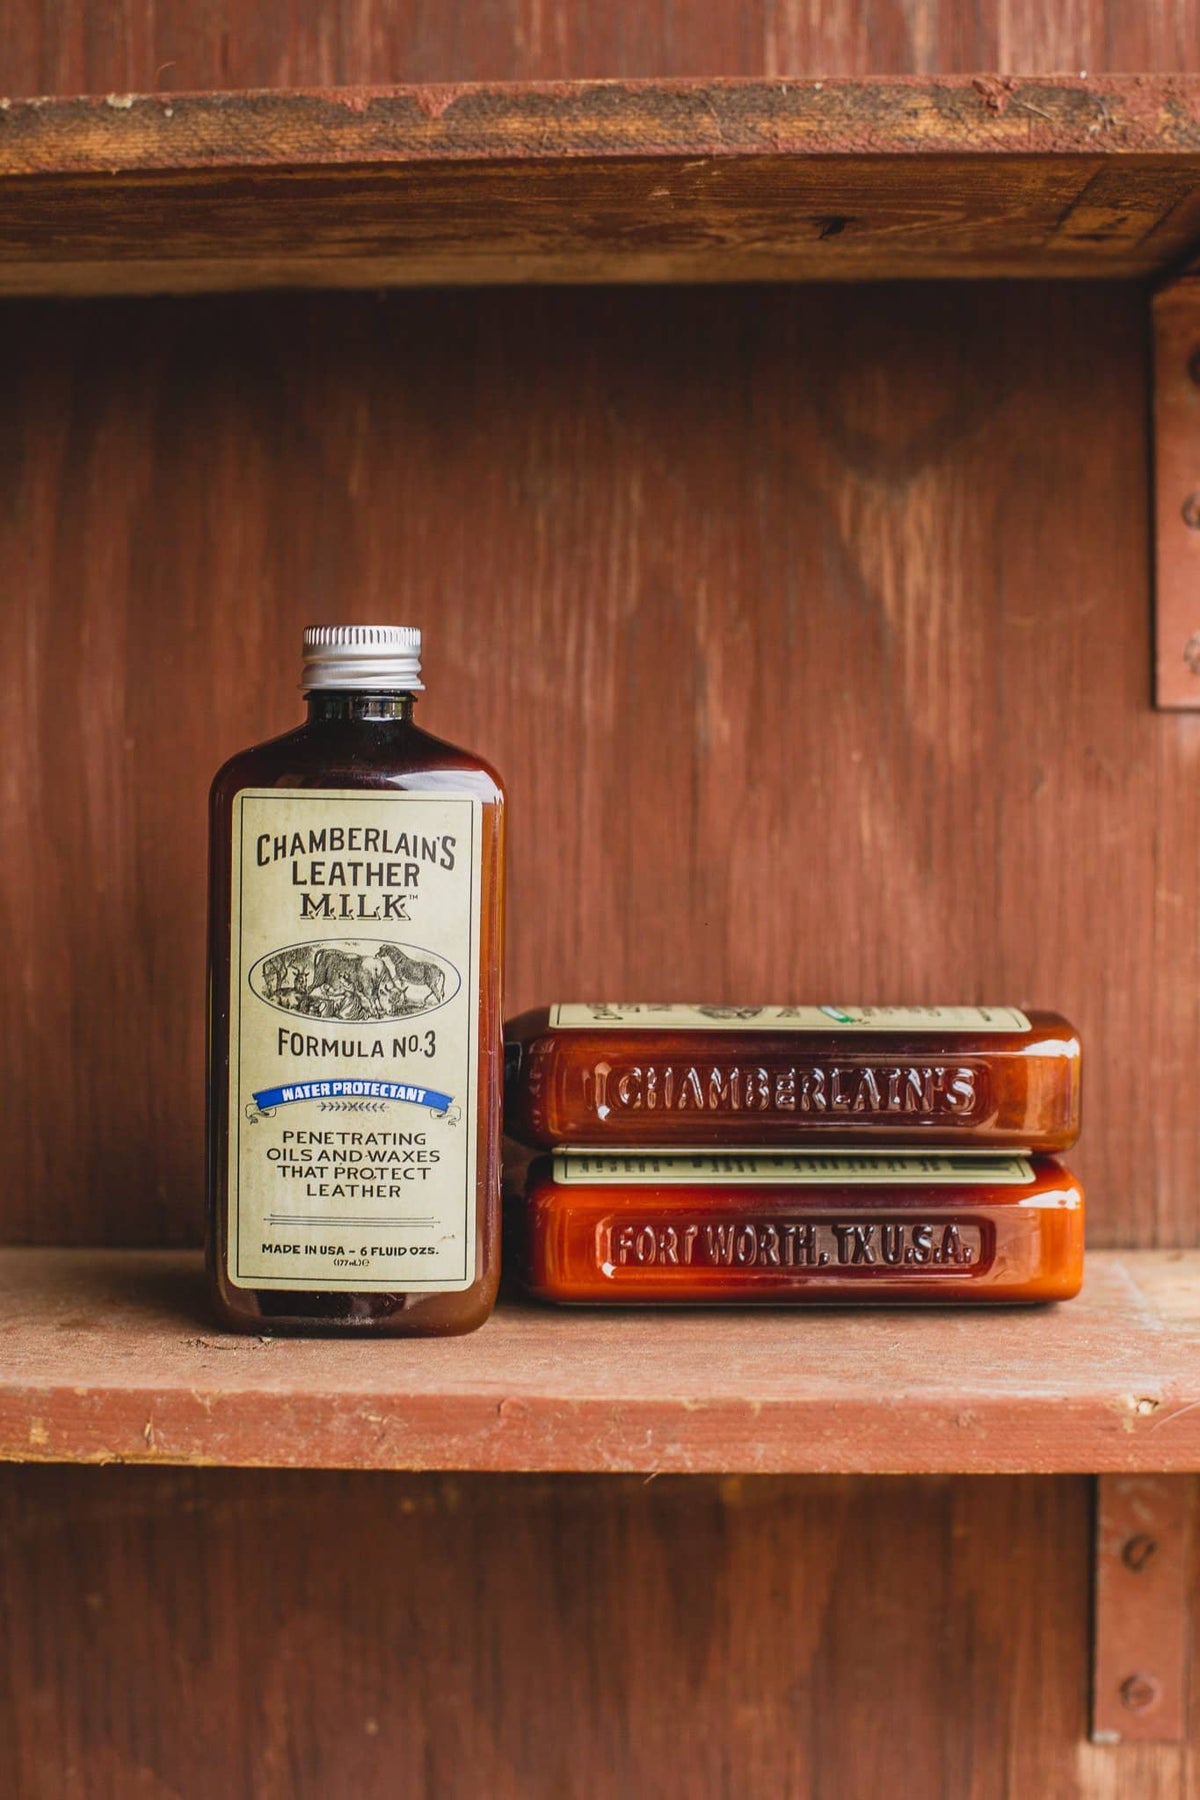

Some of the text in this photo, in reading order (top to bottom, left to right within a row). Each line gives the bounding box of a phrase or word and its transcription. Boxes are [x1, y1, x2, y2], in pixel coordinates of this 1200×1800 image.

[256, 827, 457, 871] CHAMBERLAIN'S
[291, 861, 420, 887] LEATHER
[277, 1027, 385, 1058] FORMULA
[281, 1081, 427, 1103] WATER PROTECTANT
[617, 1066, 977, 1114] CHAMBERLAIN'S
[282, 1130, 427, 1146] PENETRATING
[266, 1147, 441, 1163] OILS AND WAXES
[276, 1164, 432, 1181] THAT PROTECT
[306, 1183, 401, 1198] LEATHER
[261, 1243, 301, 1255] MADE
[304, 1245, 318, 1256] IN
[320, 1246, 345, 1256] USA
[360, 1246, 368, 1257] 6
[370, 1246, 407, 1257] FLUID
[409, 1246, 440, 1256] OZS.
[618, 1225, 697, 1265] FORT
[703, 1224, 829, 1267] WORTH,
[831, 1225, 875, 1266] TX
